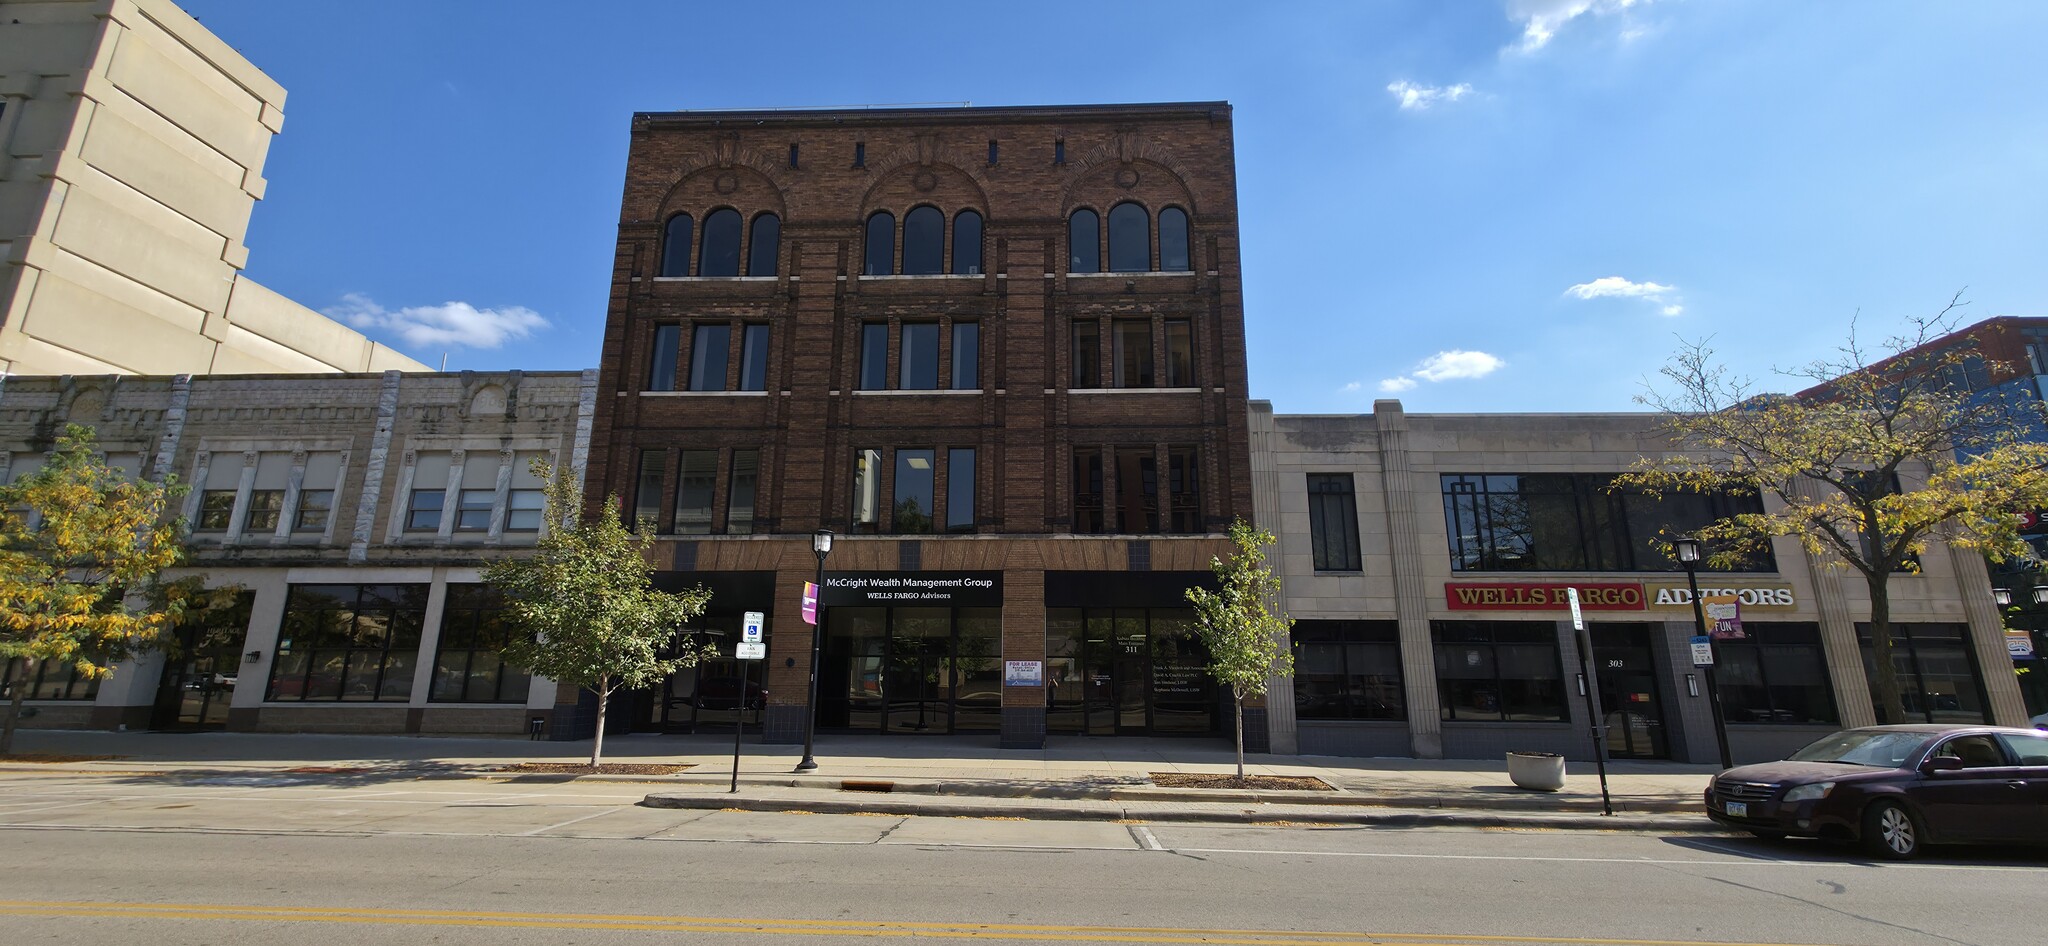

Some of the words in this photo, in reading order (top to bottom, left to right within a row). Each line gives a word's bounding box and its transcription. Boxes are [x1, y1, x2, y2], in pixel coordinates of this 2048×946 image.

[826, 578, 868, 589] McCright
[869, 578, 901, 587] Wealth
[902, 578, 962, 589] Management
[964, 578, 993, 589] Group
[1455, 588, 1547, 605] WELLS
[1714, 621, 1733, 632] FUN
[1608, 660, 1623, 668] 303
